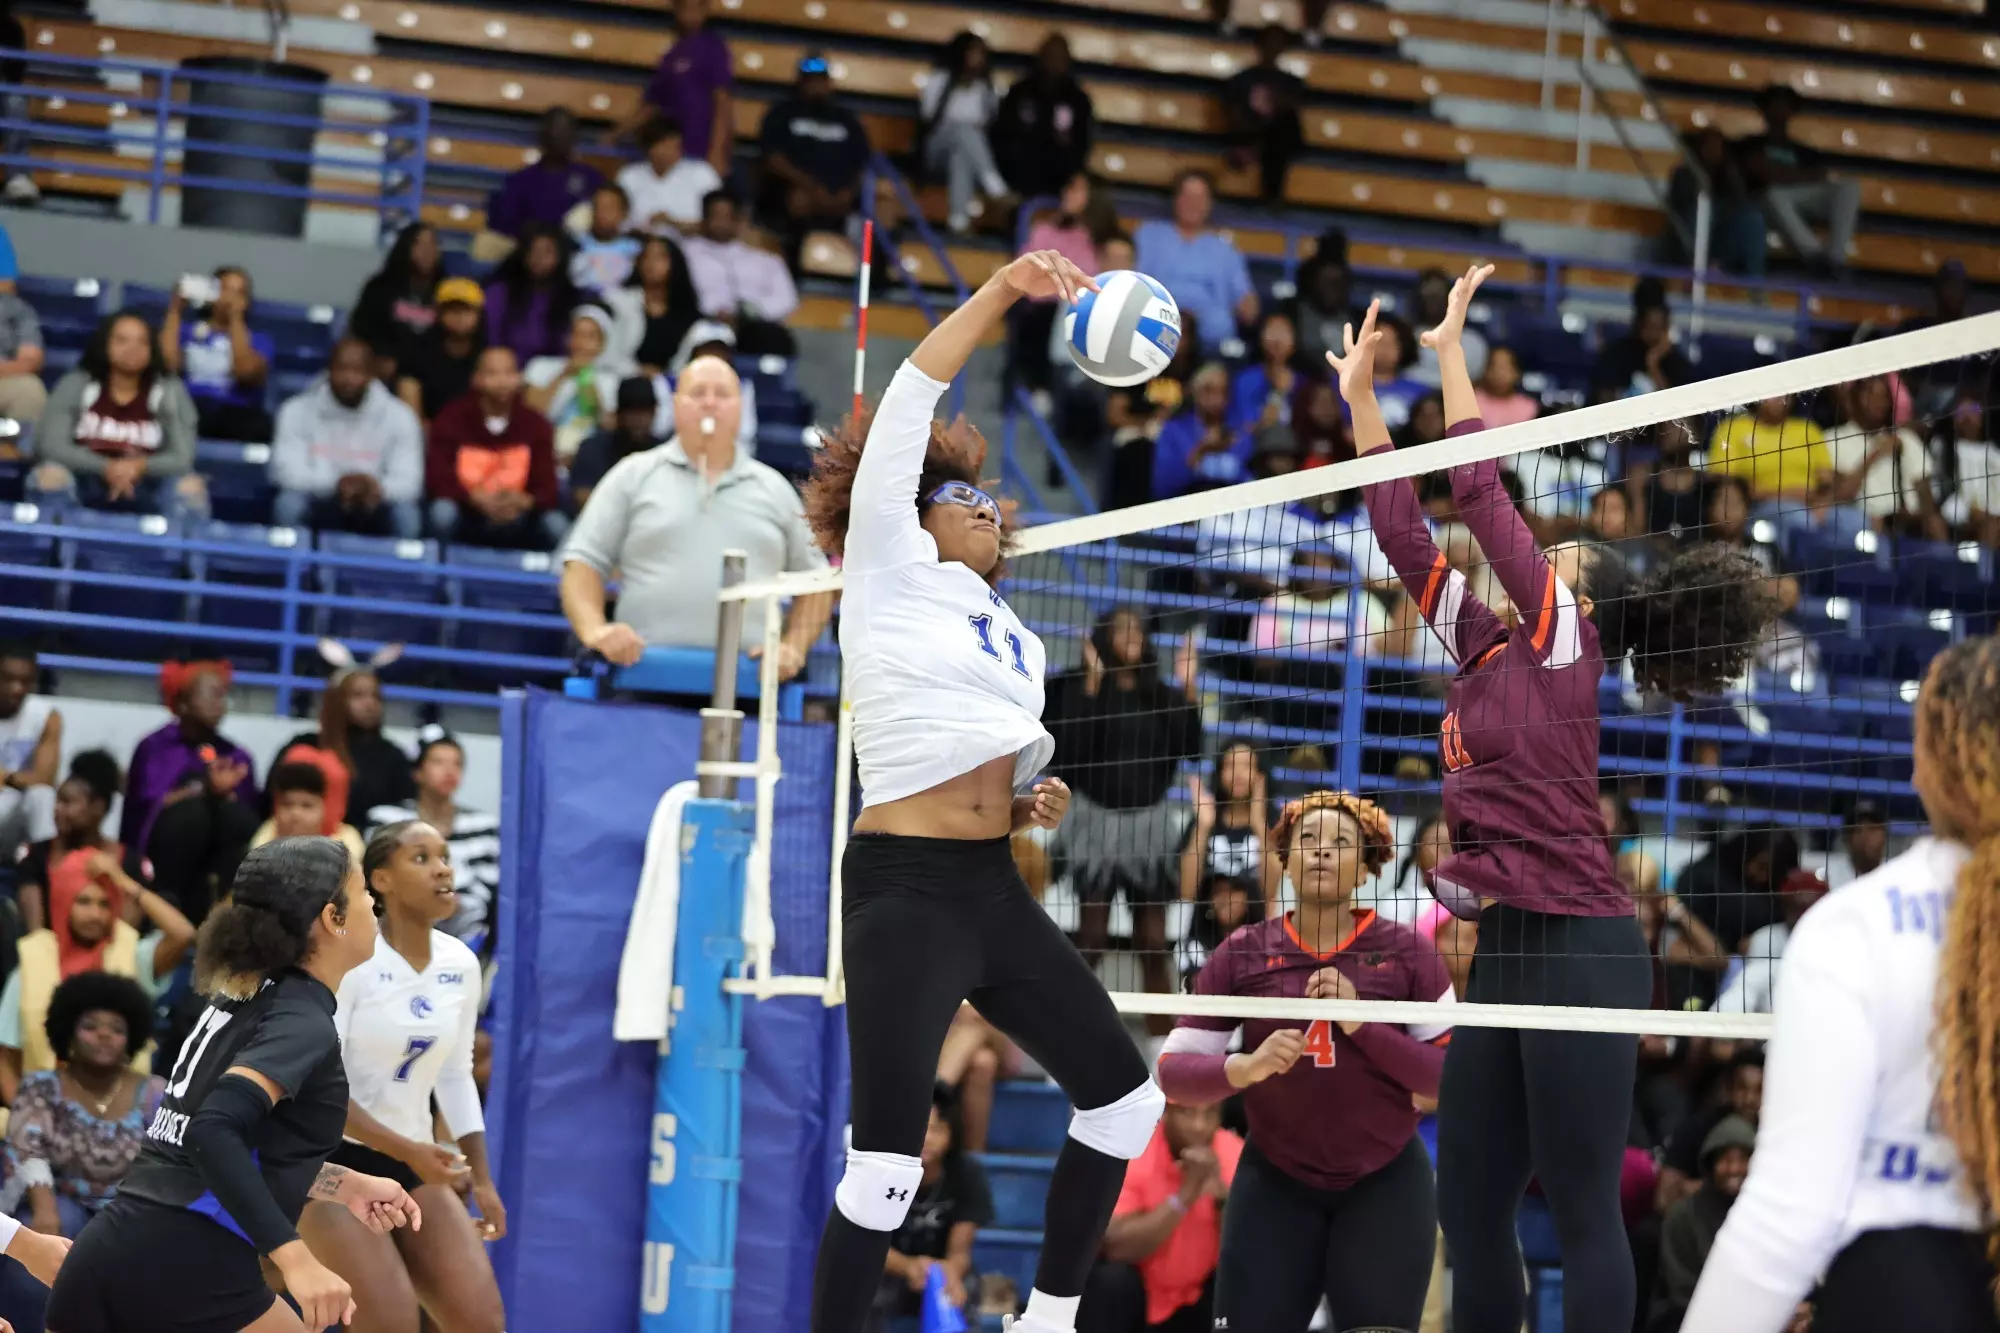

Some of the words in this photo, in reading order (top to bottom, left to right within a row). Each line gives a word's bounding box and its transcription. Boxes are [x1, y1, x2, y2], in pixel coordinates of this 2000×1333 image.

[968, 612, 1032, 682] 11
[1441, 707, 1474, 773] 11
[393, 1035, 438, 1083] 7
[1301, 1018, 1336, 1068] 4
